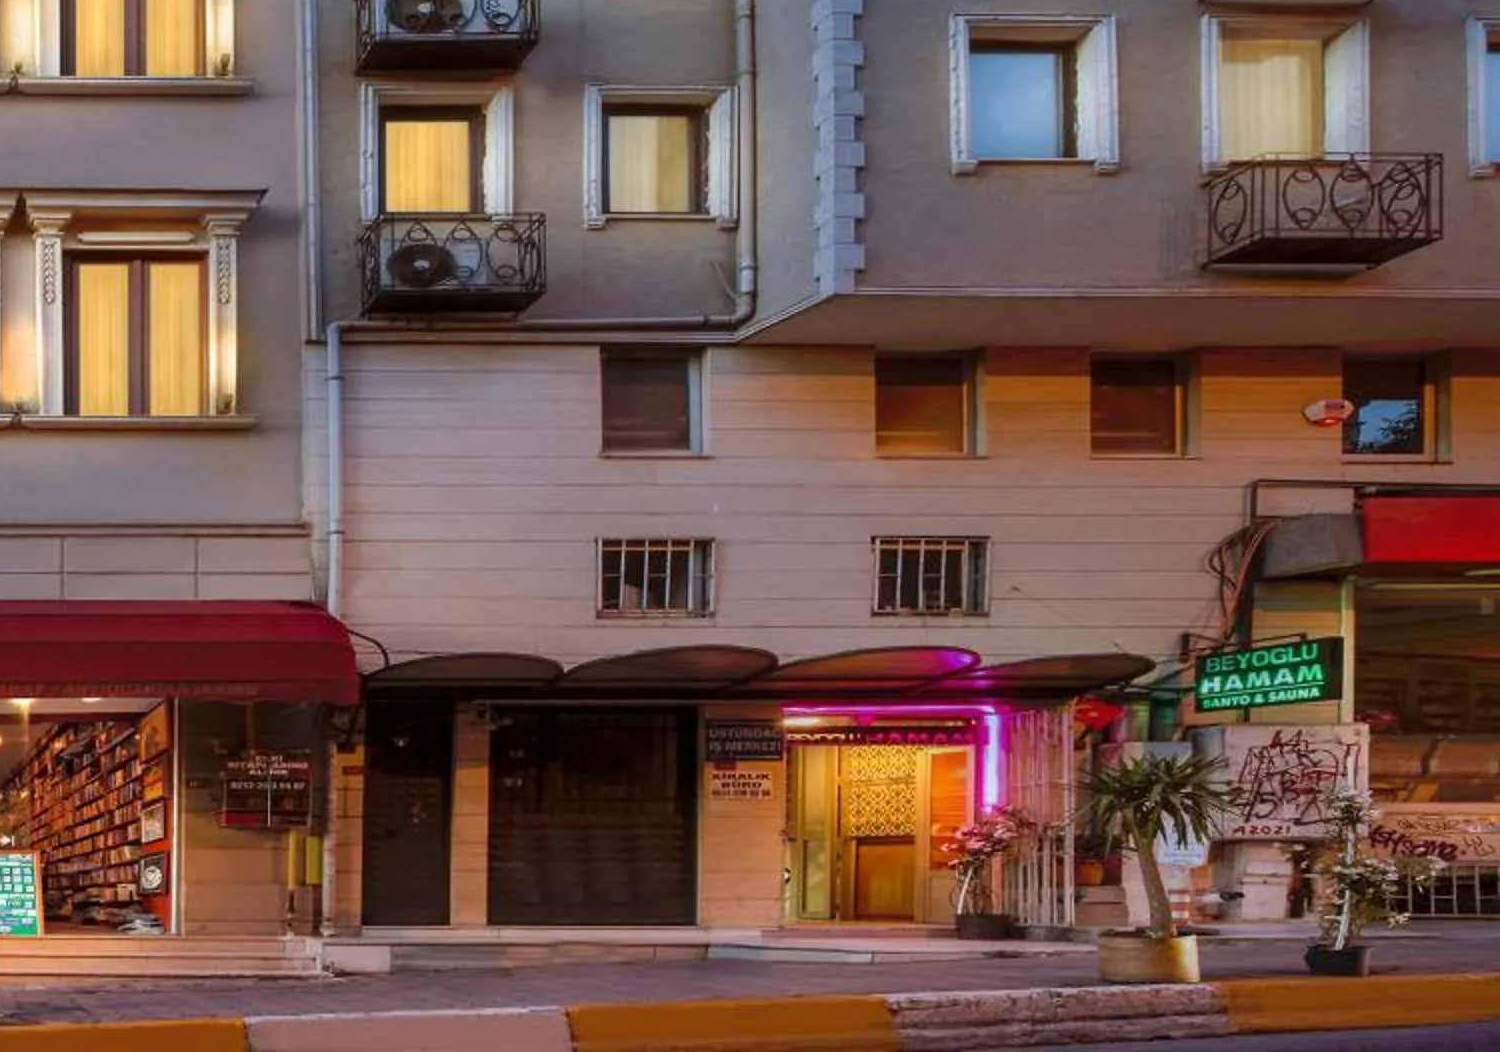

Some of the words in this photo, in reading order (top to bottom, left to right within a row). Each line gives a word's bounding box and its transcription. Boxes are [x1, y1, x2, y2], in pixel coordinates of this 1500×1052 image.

[1201, 664, 1323, 694] HAMAM
[1203, 695, 1250, 709] BANYO
[1254, 694, 1264, 703] &
[1268, 687, 1320, 703] SAUNA
